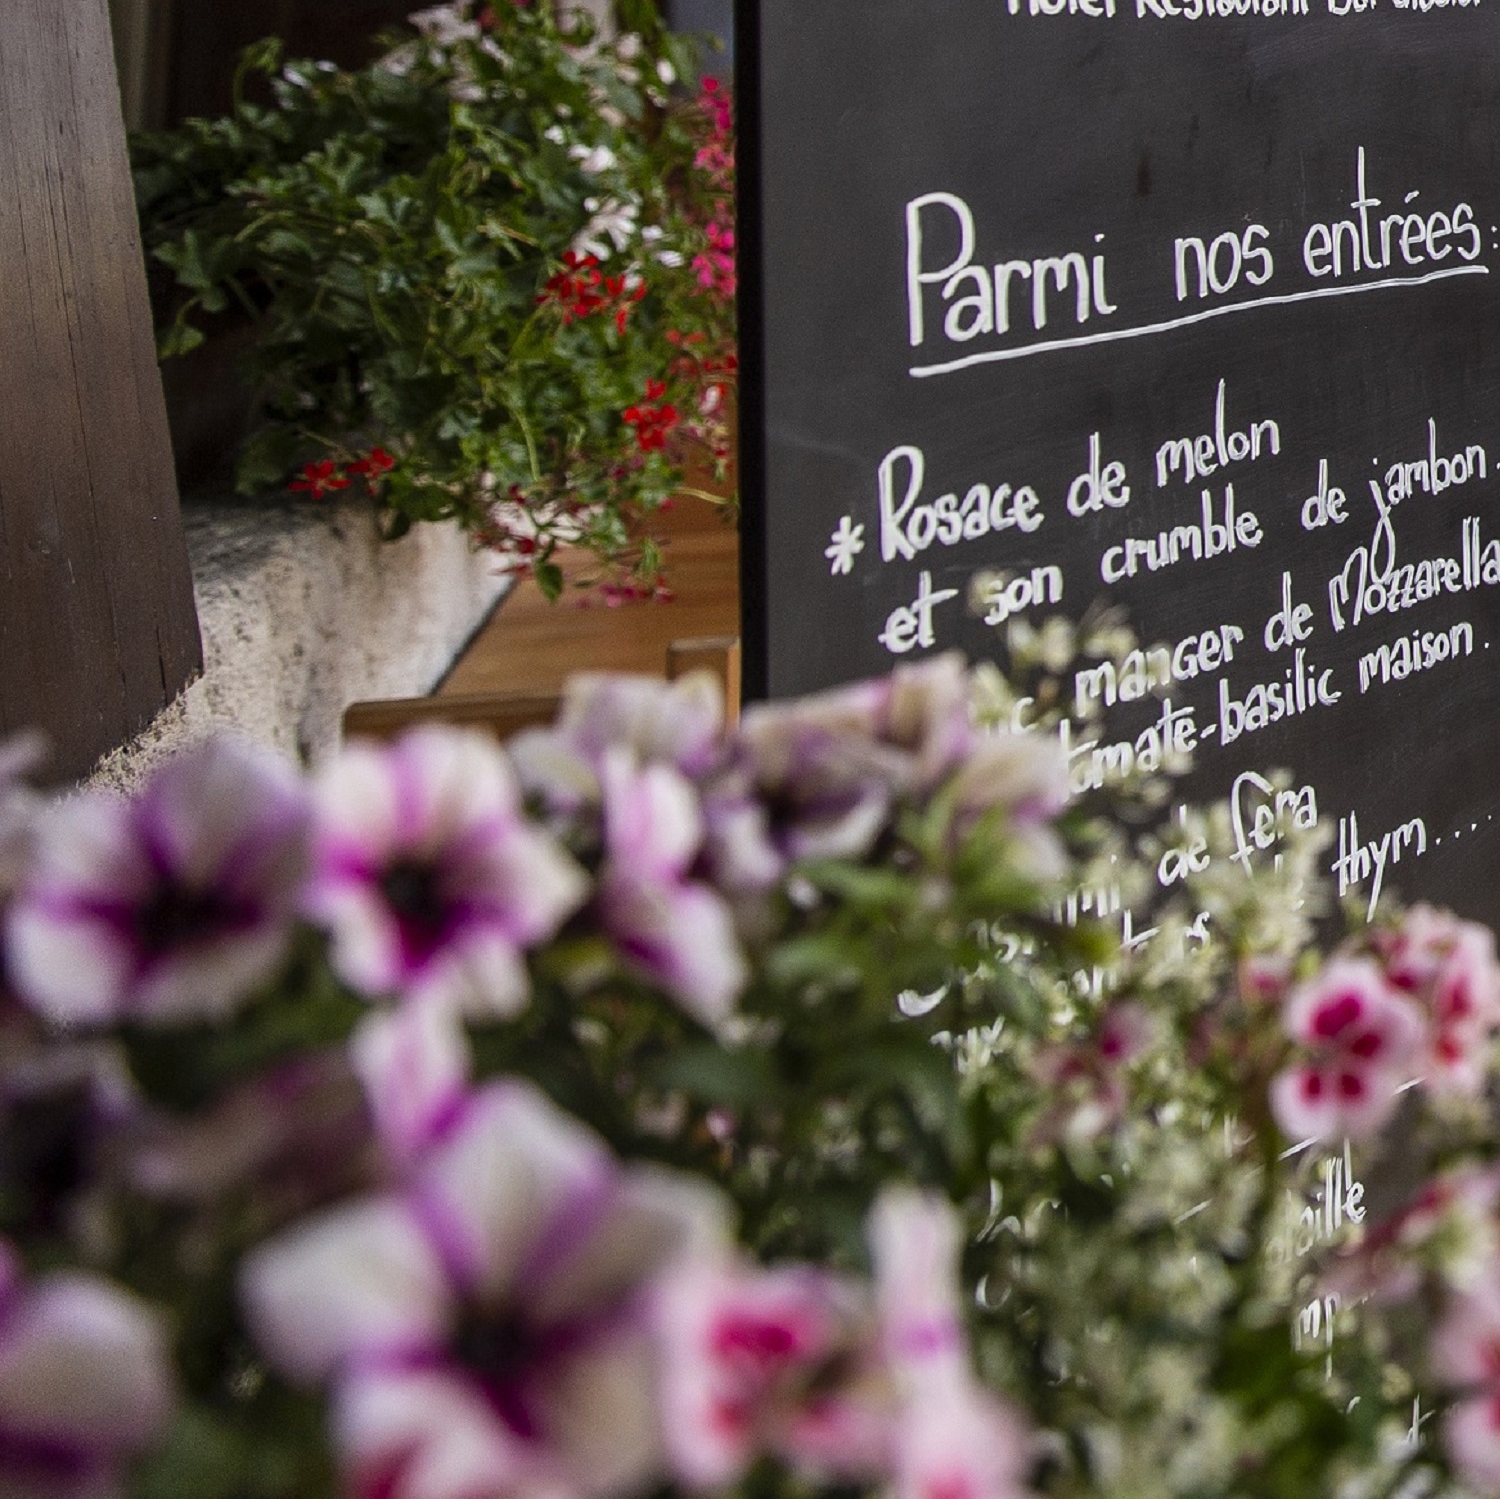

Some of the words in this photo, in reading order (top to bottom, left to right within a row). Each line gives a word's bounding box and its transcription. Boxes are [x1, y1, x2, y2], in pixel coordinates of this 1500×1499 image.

[905, 191, 1118, 346] Parmi
[1174, 224, 1276, 301] nos
[877, 445, 1045, 562] Rosace
[1066, 431, 1131, 518] de
[1156, 378, 1281, 488] melon
[877, 570, 958, 654] et
[983, 564, 1063, 626] son
[1101, 482, 1264, 584] crumble
[1301, 458, 1350, 531] de
[1368, 417, 1487, 585] jambon
[1264, 570, 1314, 652] de
[1358, 621, 1473, 694] maison
[1157, 803, 1211, 887] de
[1229, 770, 1318, 880] fera
[1331, 809, 1428, 924] thym
